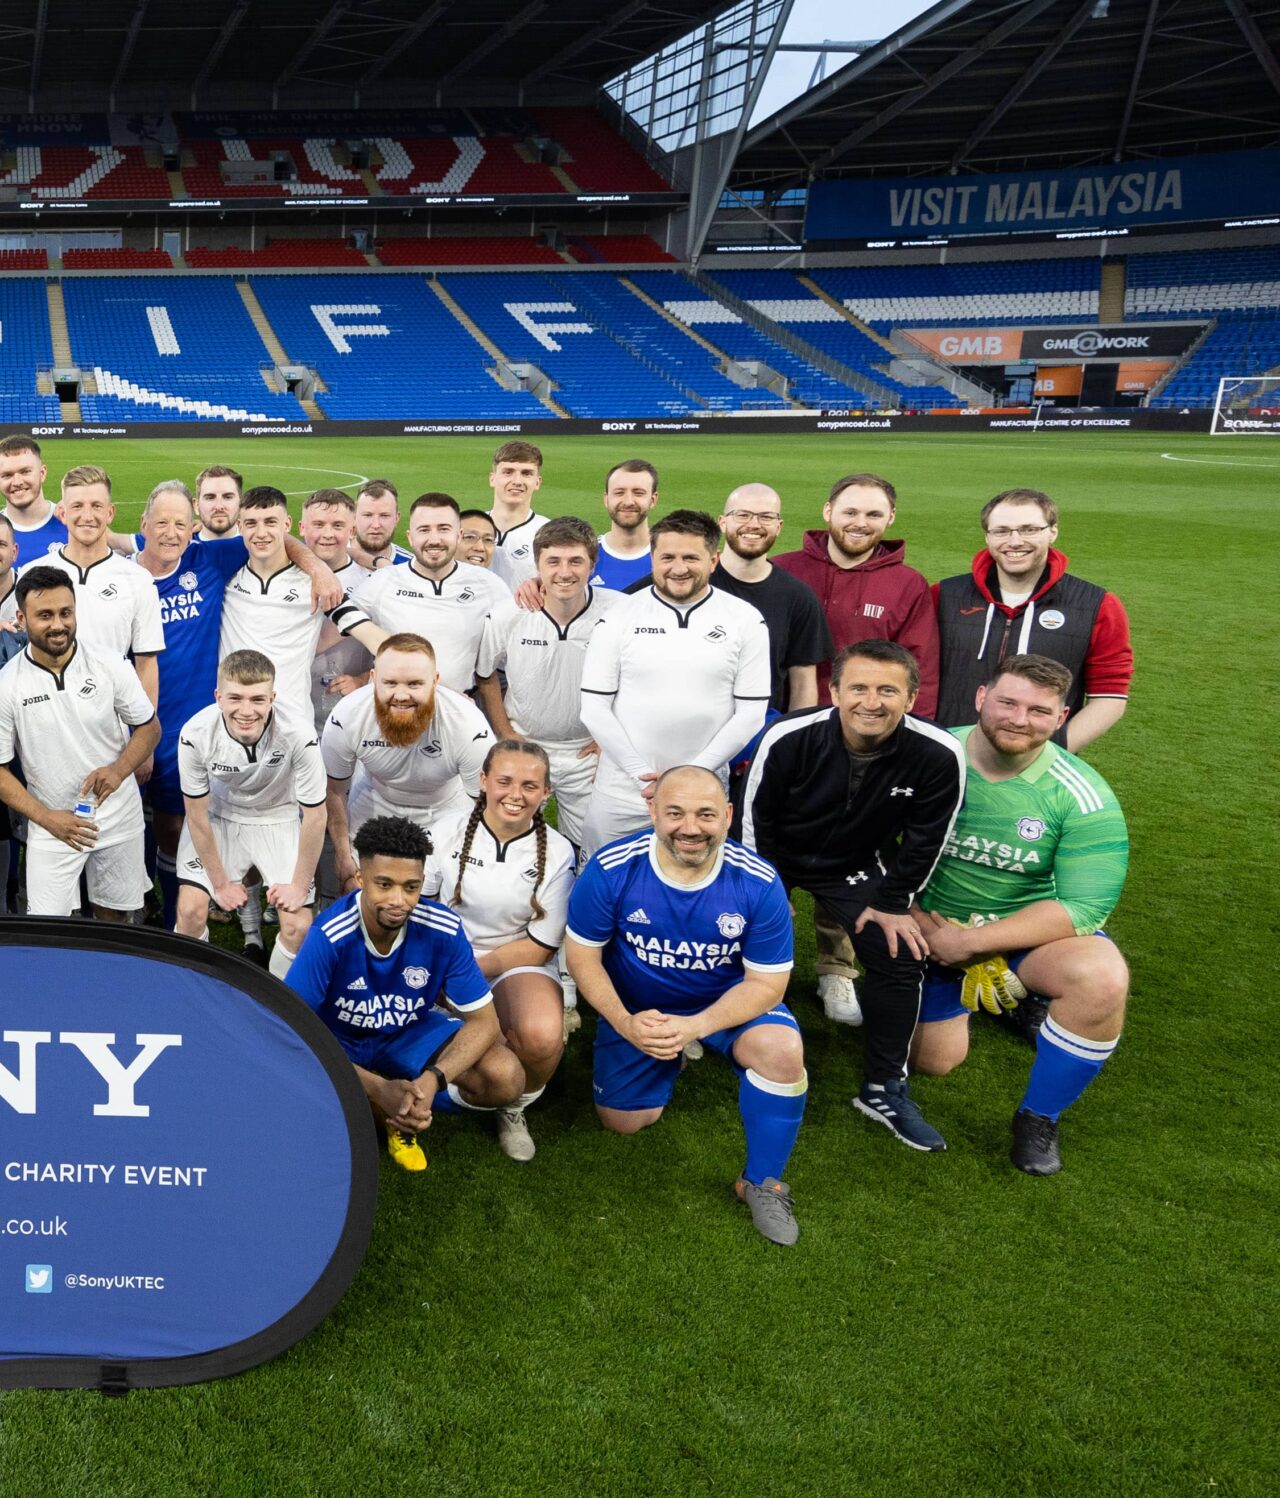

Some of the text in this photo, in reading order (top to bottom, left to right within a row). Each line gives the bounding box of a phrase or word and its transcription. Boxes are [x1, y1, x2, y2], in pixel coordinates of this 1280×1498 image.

[889, 169, 1184, 227] VISIT MALAYSIA
[939, 336, 1003, 356] GMB
[403, 425, 452, 433] MANUFACTURING
[601, 422, 637, 431] SONY
[653, 423, 682, 431] Technology
[816, 419, 892, 430] sonypencoed.co.uk
[989, 419, 1044, 427] MANUFACTURING
[1044, 419, 1070, 427] CENTRE
[31, 427, 65, 435] SONY
[81, 427, 109, 435] Technology
[241, 424, 313, 435] sonypencoed.co.uk
[395, 588, 425, 599] Joma
[863, 603, 885, 620] HUF
[633, 626, 666, 635] Joma
[520, 637, 549, 647] Joma
[22, 693, 51, 707] Joma
[211, 762, 241, 773] Joma
[625, 931, 741, 958] MALAYSIA
[635, 946, 732, 971] BERJAYA
[334, 994, 426, 1015] MALAYSIA
[337, 1010, 419, 1029] BERJAYA
[4, 1161, 116, 1184] CHARITY
[124, 1164, 208, 1187] EVENT
[64, 1273, 165, 1292] @SonyUKTEC
